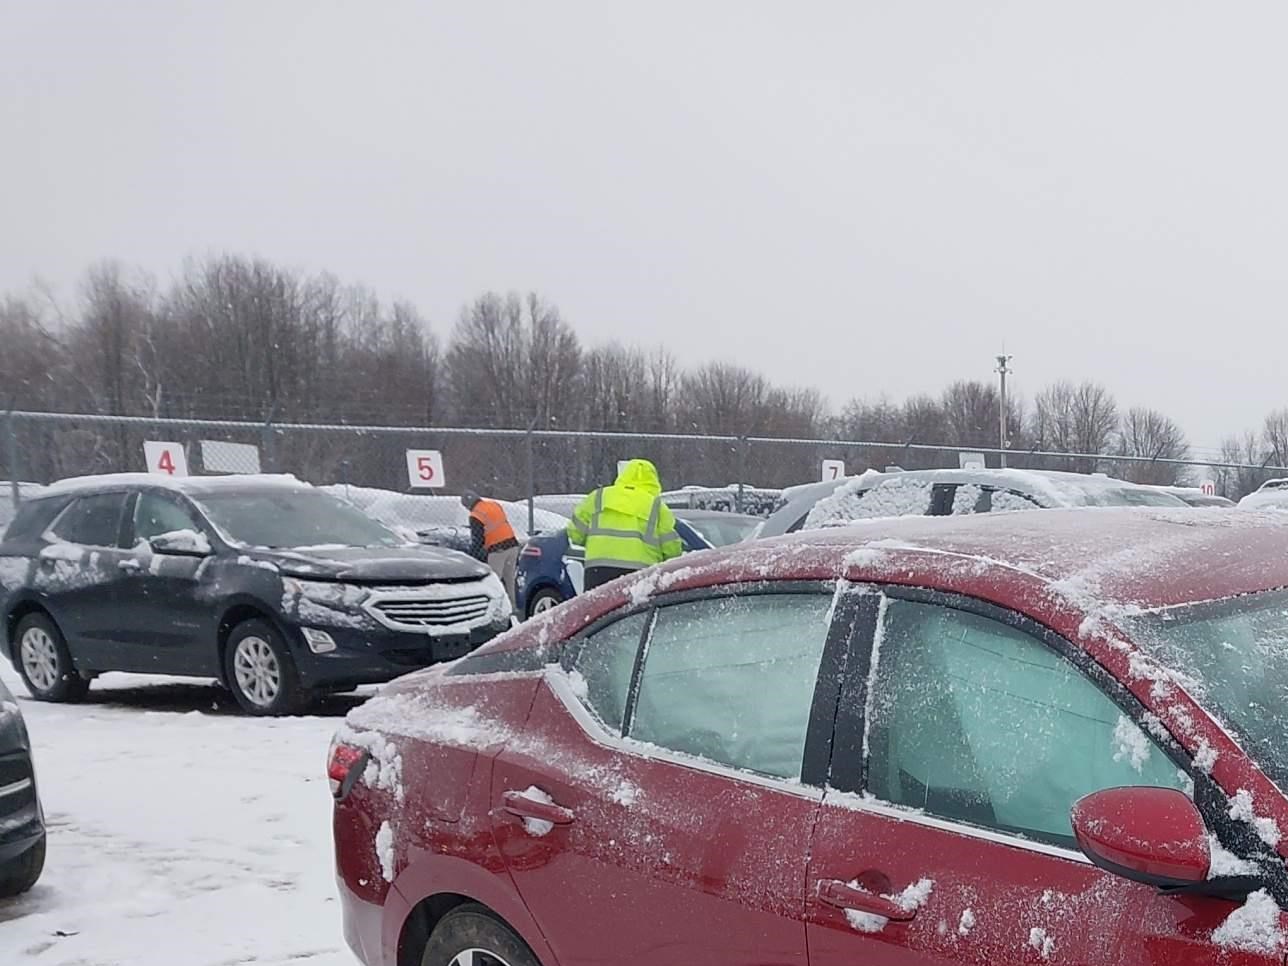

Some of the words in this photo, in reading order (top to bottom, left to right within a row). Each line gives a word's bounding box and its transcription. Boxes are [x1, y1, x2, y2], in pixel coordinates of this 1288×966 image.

[159, 450, 176, 475] 4
[418, 457, 434, 480] 5
[829, 466, 839, 480] 7
